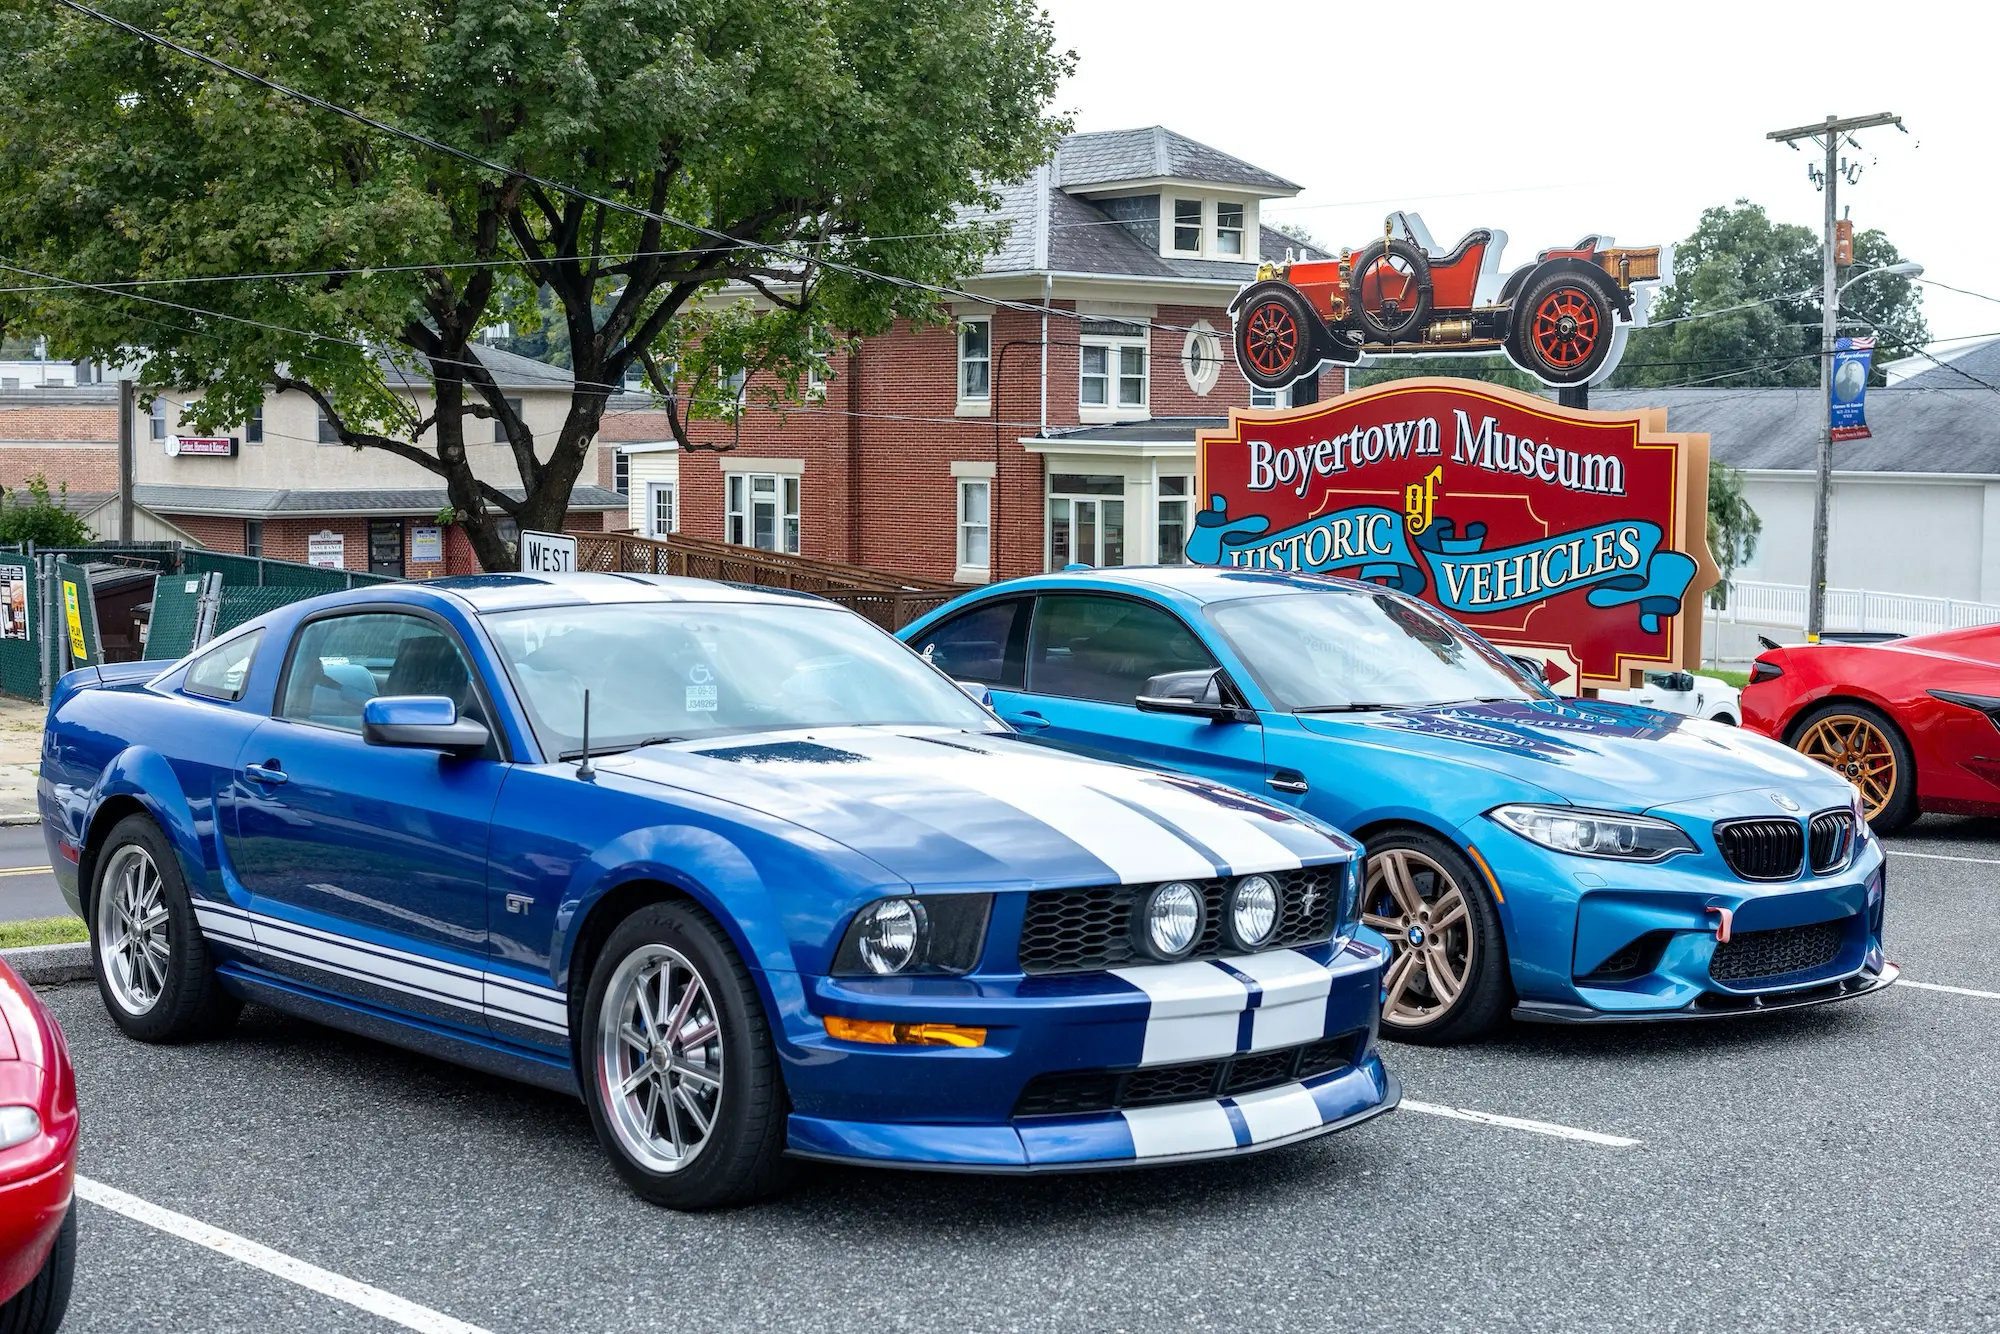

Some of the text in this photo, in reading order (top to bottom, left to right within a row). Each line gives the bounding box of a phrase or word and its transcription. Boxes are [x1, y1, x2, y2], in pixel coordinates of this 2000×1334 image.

[1247, 409, 1626, 497] Boyertown Museum
[1404, 465, 1443, 537] of
[528, 541, 570, 572] WEST
[1440, 527, 1642, 606] VEHICLES
[71, 626, 81, 637] PLAY
[506, 893, 535, 916] GT
